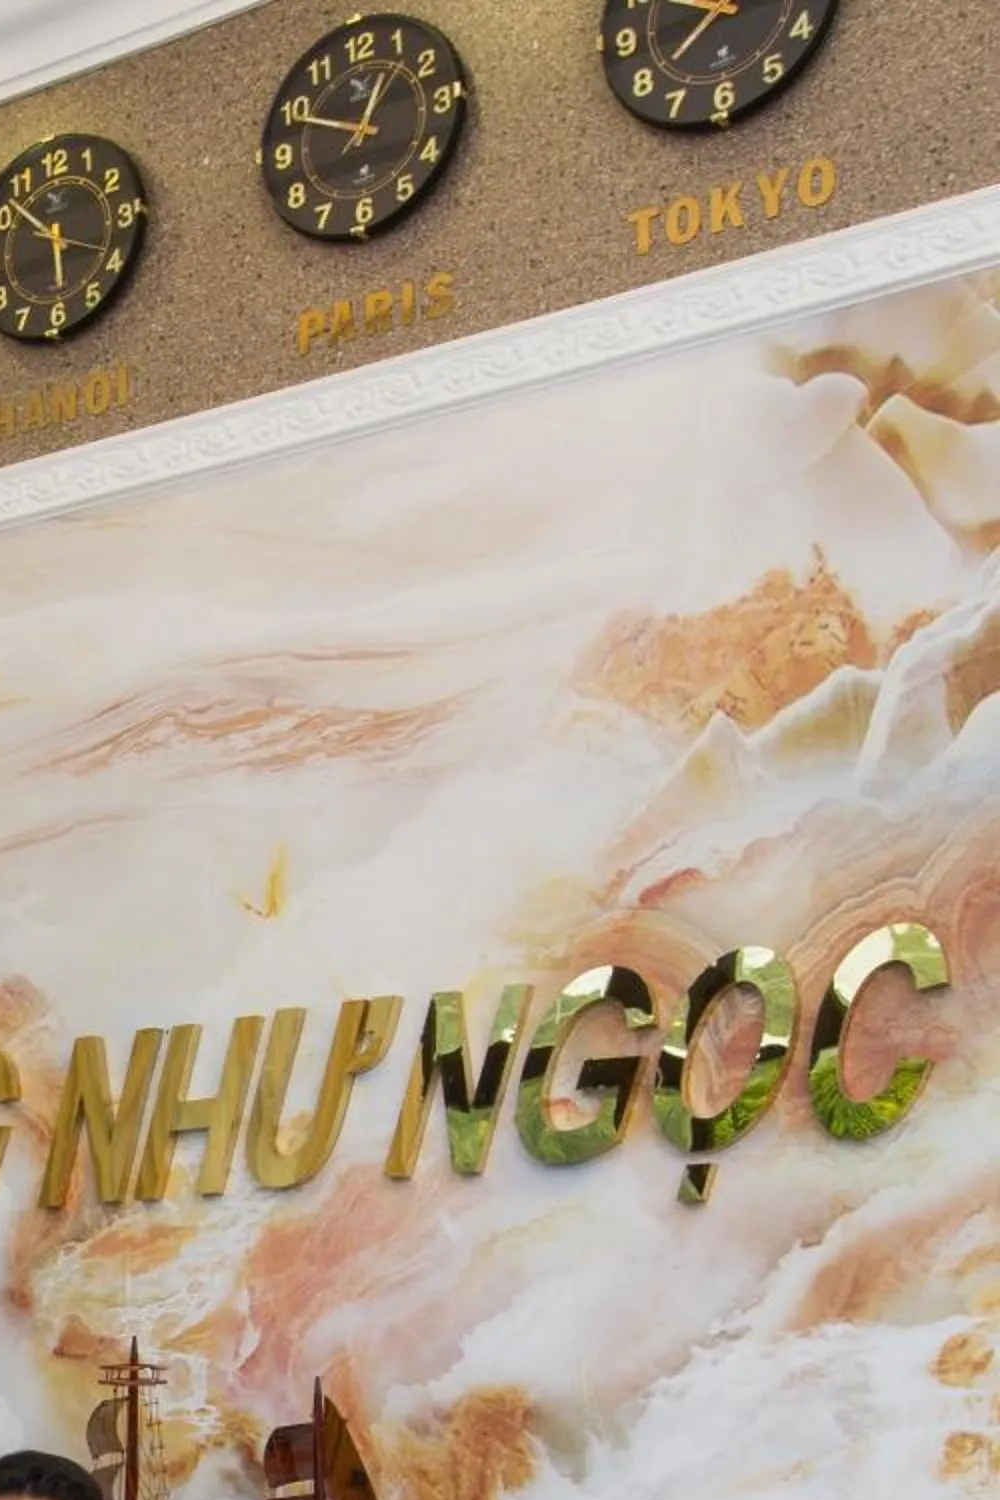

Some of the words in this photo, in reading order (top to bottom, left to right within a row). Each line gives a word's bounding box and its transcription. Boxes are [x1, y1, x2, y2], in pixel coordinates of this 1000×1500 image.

[789, 10, 813, 39] 4
[344, 32, 375, 63] 12
[392, 28, 403, 54] 1
[616, 27, 637, 57] 9
[307, 55, 331, 85] 11
[418, 48, 435, 78] 2
[762, 53, 784, 84] 5
[633, 68, 654, 97] 8
[713, 81, 735, 110] 6
[281, 96, 309, 126] 10
[433, 85, 450, 113] 3
[665, 88, 687, 119] 7
[82, 148, 91, 171] 1
[275, 144, 292, 169] 9
[420, 136, 439, 163] 4
[41, 150, 69, 178] 12
[9, 167, 31, 197] 11
[105, 168, 120, 193] 2
[396, 174, 414, 202] 5
[288, 183, 305, 209] 8
[627, 158, 837, 256] TOKYO
[118, 203, 132, 228] 3
[314, 202, 332, 230] 7
[356, 198, 373, 223] 6
[106, 248, 123, 272] 4
[85, 282, 100, 308] 5
[15, 306, 31, 331] 7
[51, 302, 66, 326] 6
[297, 271, 455, 357] PARIS
[37, 994, 403, 1210] NHƯ
[385, 922, 951, 1204] NGỌC
